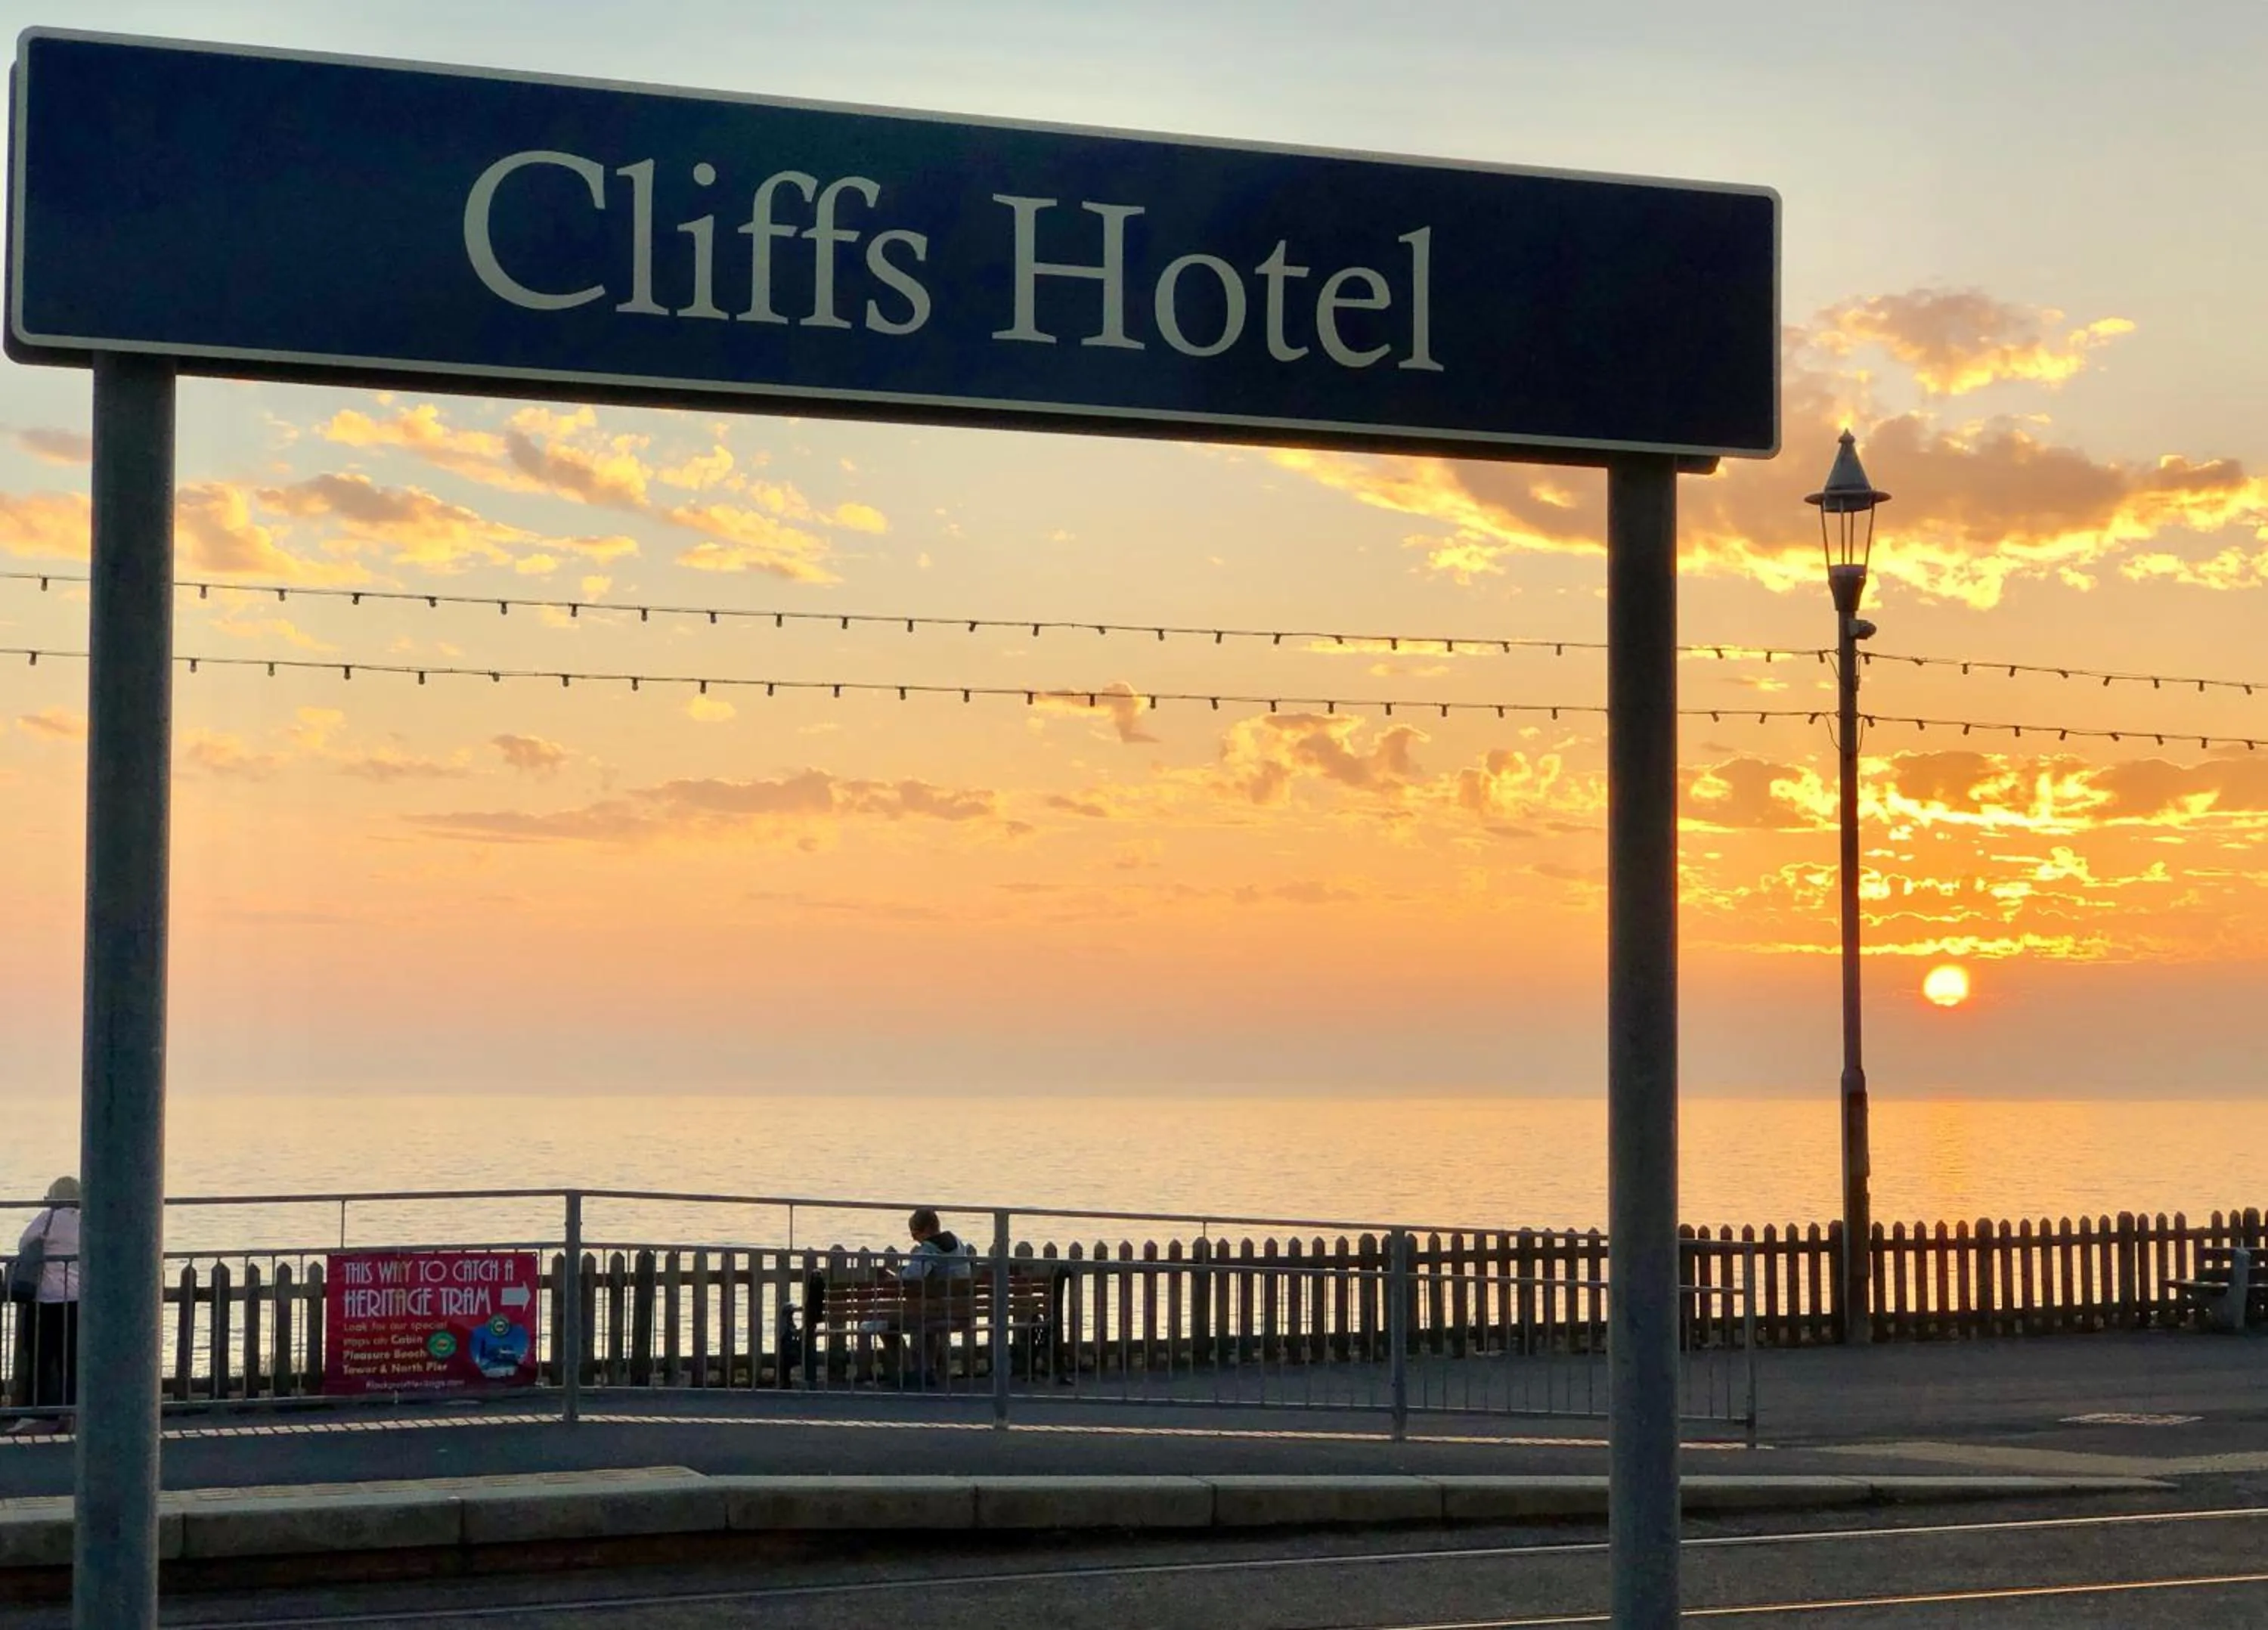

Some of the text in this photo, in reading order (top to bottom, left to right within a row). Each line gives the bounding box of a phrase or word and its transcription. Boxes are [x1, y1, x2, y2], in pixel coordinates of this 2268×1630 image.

[463, 150, 1444, 372] Cliffs Hotel
[344, 1259, 513, 1283] THIS WAY TO CATCH A
[344, 1286, 491, 1318] HERITAGE TRAM
[344, 1323, 367, 1331] Look
[372, 1322, 386, 1331] for
[411, 1321, 448, 1331] special
[391, 1334, 423, 1344] Cabin
[343, 1348, 427, 1360] Pleasure Beach
[343, 1362, 448, 1374] Tower & North Pier
